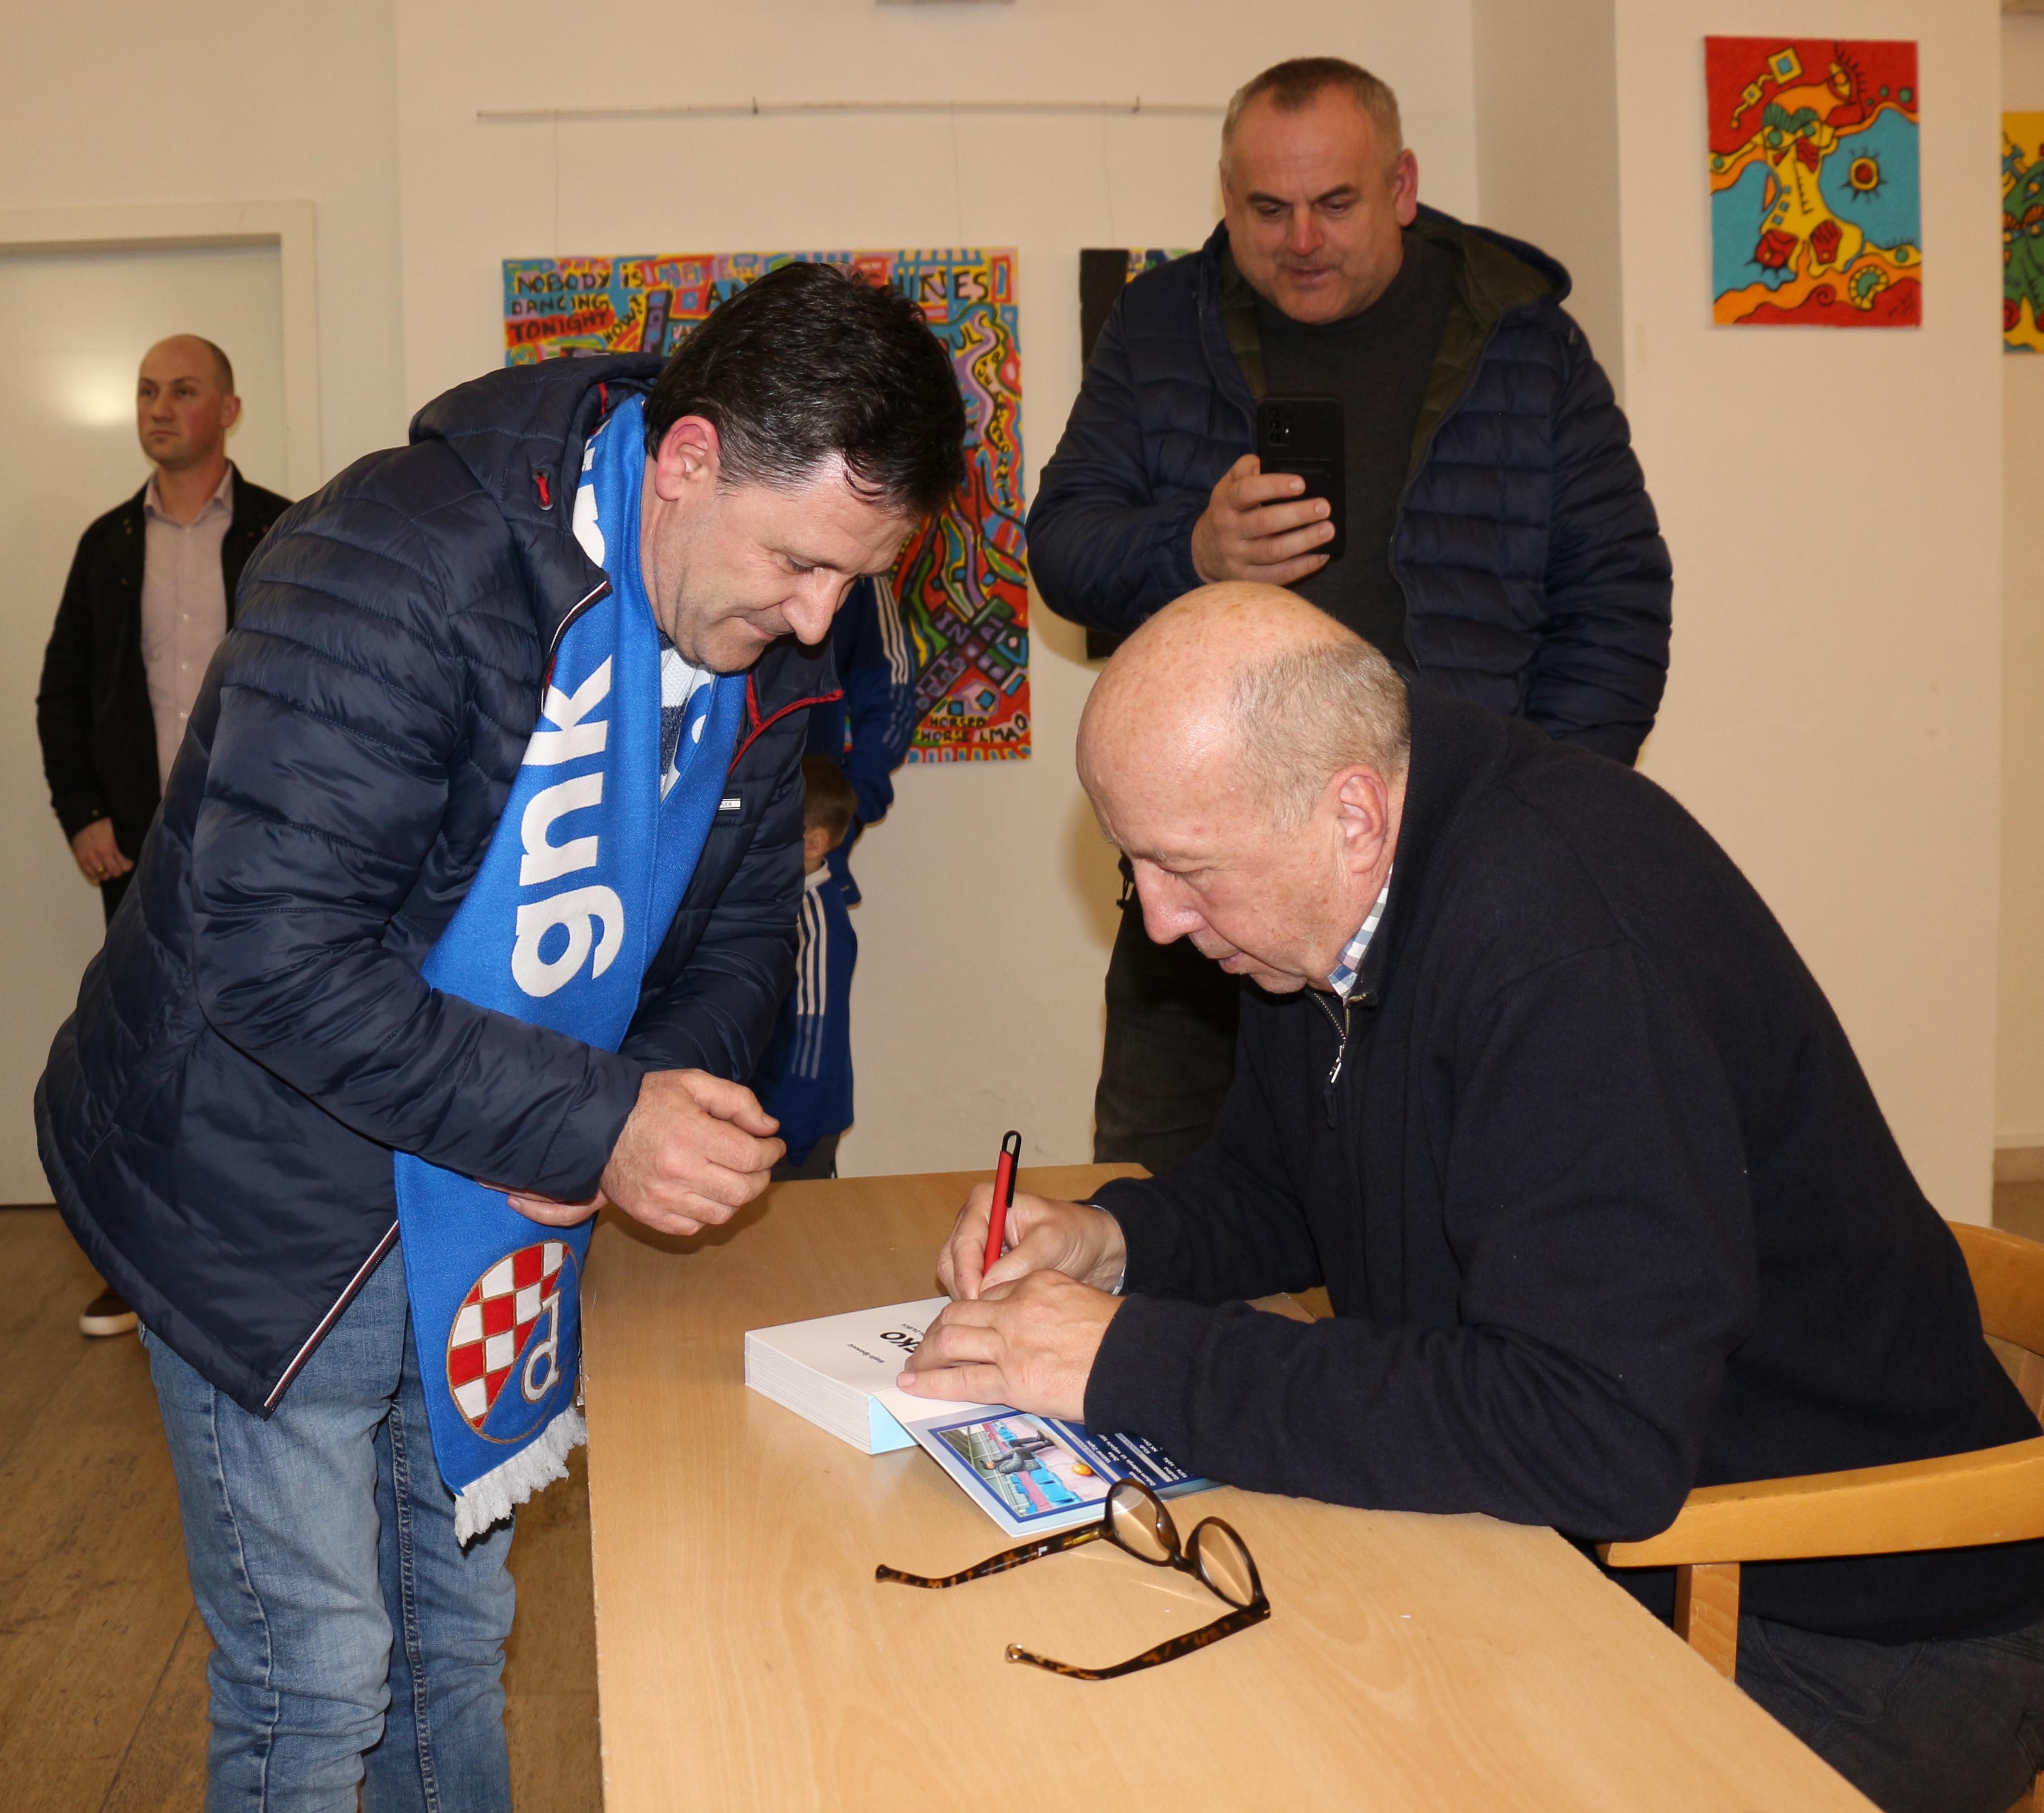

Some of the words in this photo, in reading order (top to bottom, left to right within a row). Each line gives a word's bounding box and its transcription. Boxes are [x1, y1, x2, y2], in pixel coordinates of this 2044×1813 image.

[515, 272, 611, 294] NOBODY
[511, 294, 609, 316] DANCING
[508, 312, 608, 342] TONIGHT
[980, 712, 1029, 743] LMAO
[511, 655, 624, 997] gnk
[1139, 1444, 1151, 1454] Klub
